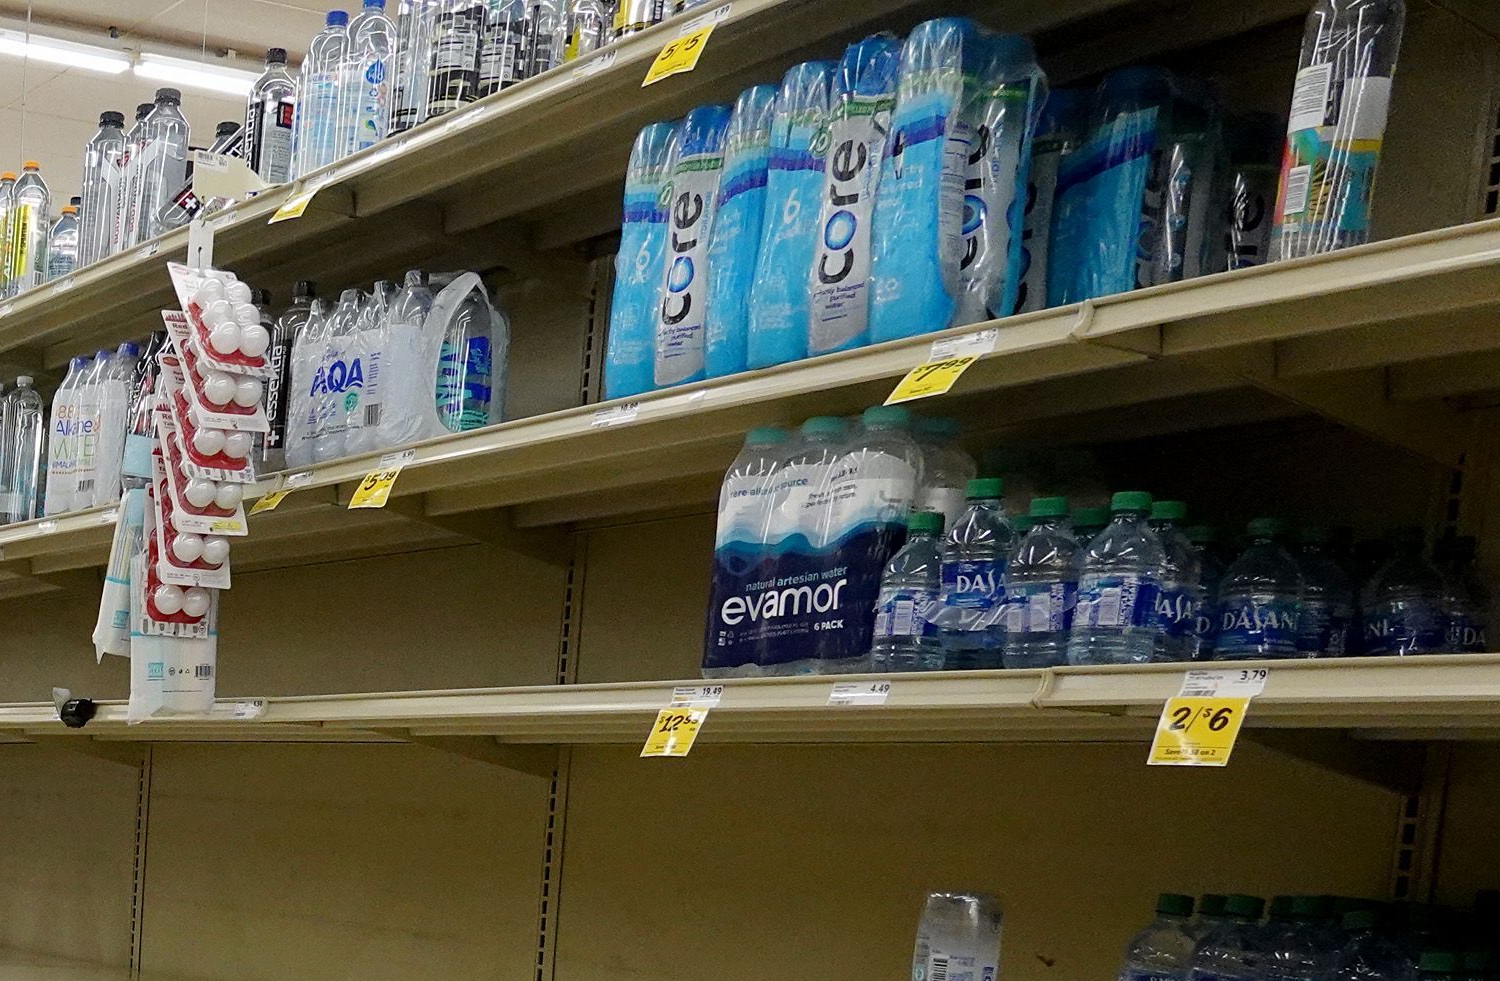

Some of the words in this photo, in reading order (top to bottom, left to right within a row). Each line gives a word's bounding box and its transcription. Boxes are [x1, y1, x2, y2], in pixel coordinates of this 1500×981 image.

[245, 107, 257, 168] ssentia
[783, 188, 800, 225] 6
[818, 139, 867, 284] core
[662, 191, 704, 325] core
[745, 578, 776, 593] natural
[777, 572, 819, 587] artesian
[821, 566, 848, 580] water
[956, 568, 1007, 599] DASA
[721, 578, 847, 626] evamor
[813, 622, 820, 631] 6
[821, 619, 844, 630] PACK
[869, 683, 890, 693] 4.49
[1240, 669, 1267, 681] 3.79
[702, 686, 723, 696] 19.49
